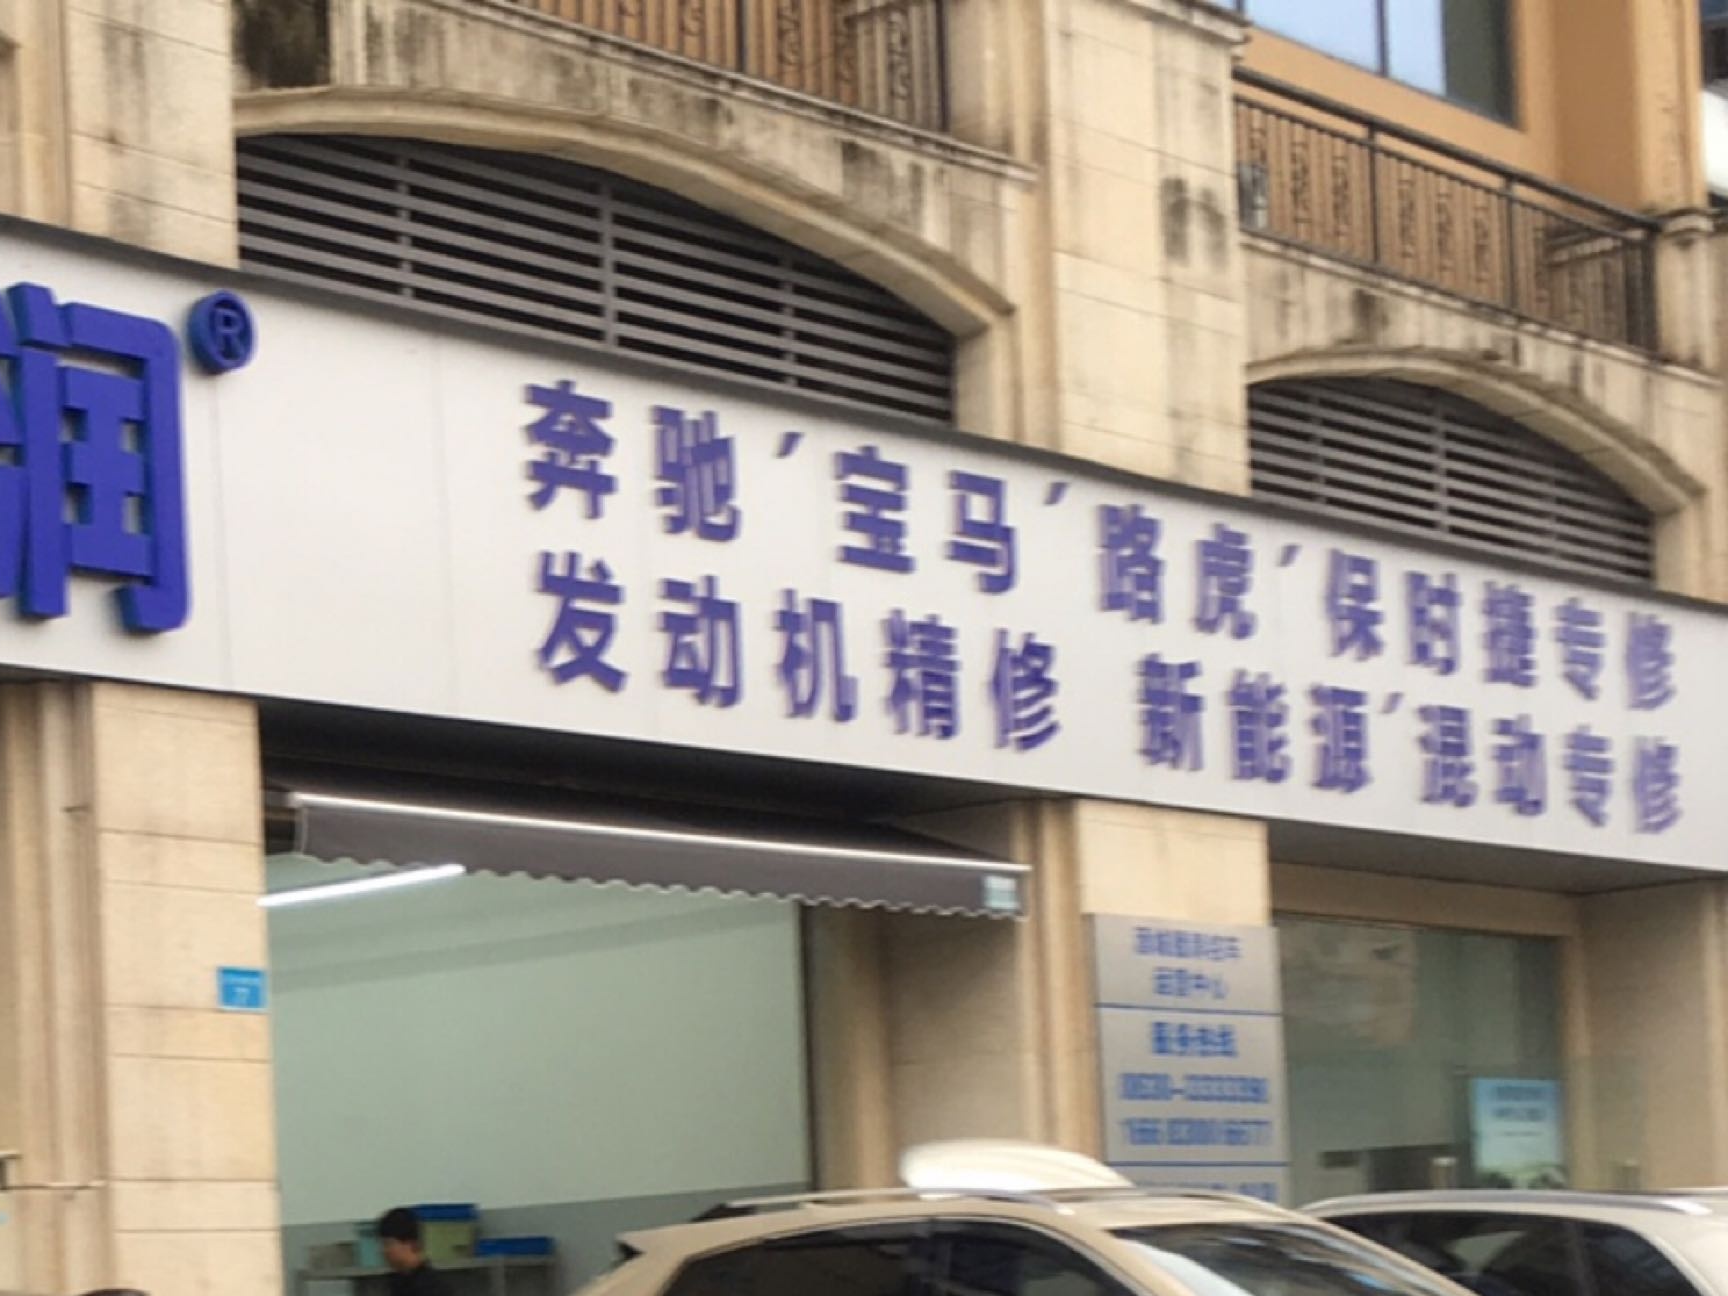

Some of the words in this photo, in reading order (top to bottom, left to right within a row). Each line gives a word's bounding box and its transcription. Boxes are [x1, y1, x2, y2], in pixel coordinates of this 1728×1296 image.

[534, 551, 1060, 751] 发动机精修
